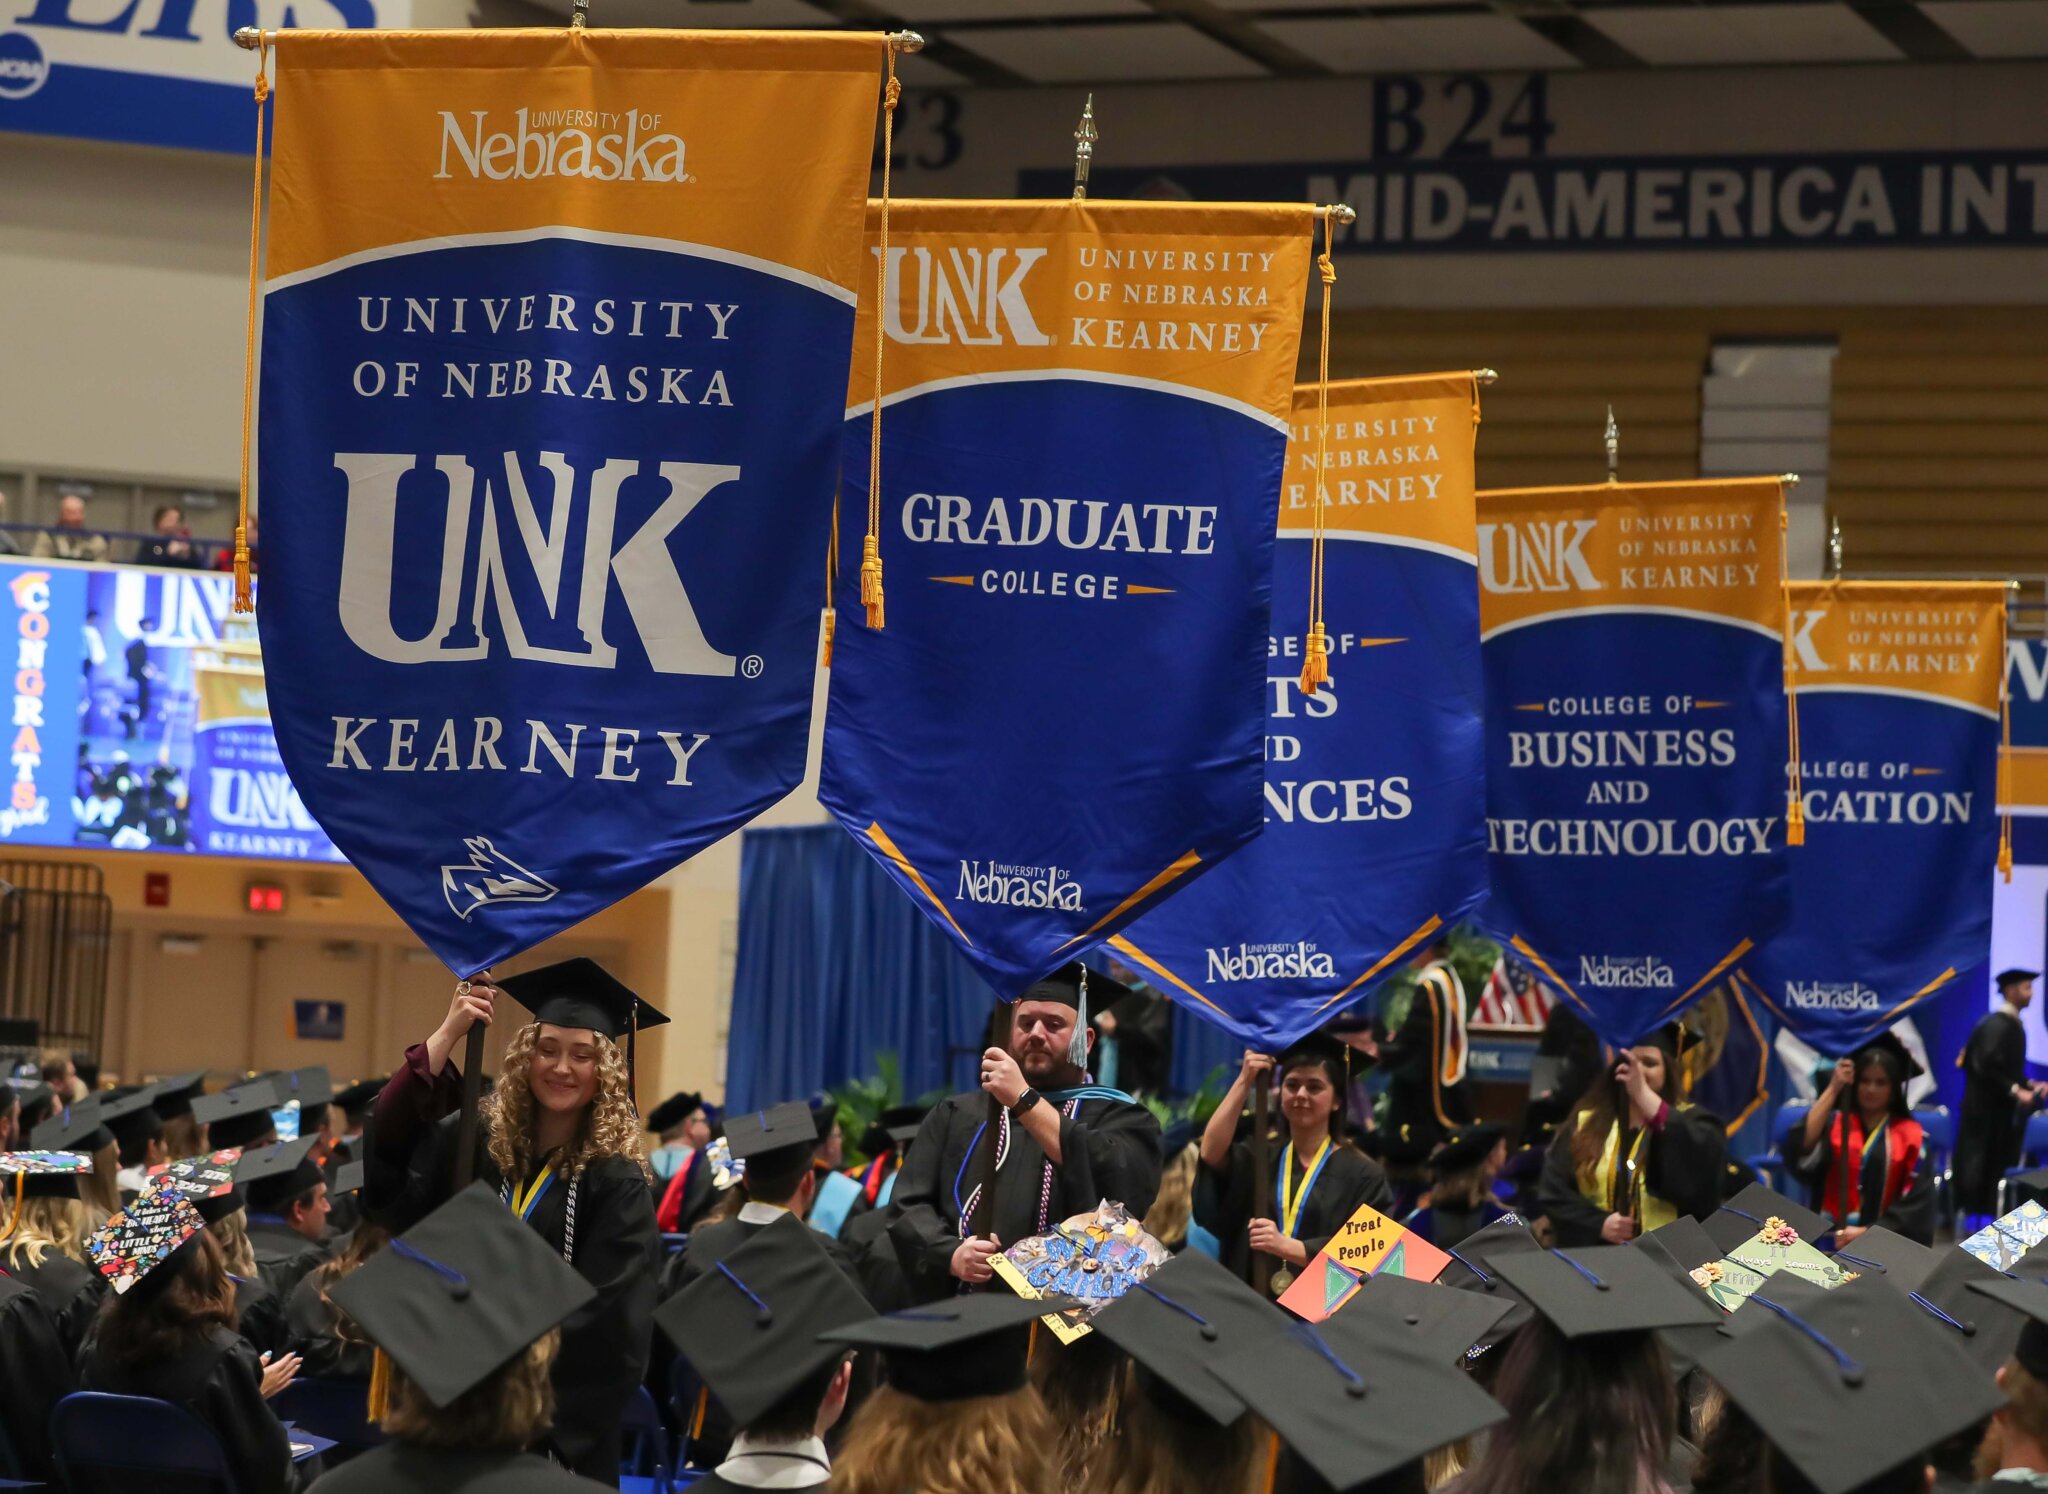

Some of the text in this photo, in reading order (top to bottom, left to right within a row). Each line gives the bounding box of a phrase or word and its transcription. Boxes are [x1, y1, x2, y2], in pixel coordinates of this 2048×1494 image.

[532, 109, 661, 131] UNIVERSITY OF
[1371, 72, 1555, 159] B24
[433, 107, 690, 183] Nebraska
[1305, 165, 1897, 243] MID-AMERICA
[1079, 247, 1275, 273] UNIVERSITY
[871, 247, 1050, 346] UNK
[1074, 281, 1269, 307] OF NEBRASKA
[359, 294, 738, 339] UNIVERSITY
[1071, 318, 1269, 352] KEARNEY
[354, 358, 734, 406] OF NEBRASKA
[1287, 416, 1437, 442] NIVERSITY
[1302, 444, 1440, 470] NEBRASKA
[1281, 474, 1442, 509] EARNEY
[902, 493, 1217, 555] GRADUATE
[1619, 514, 1755, 533] UNIVERSITY
[1476, 520, 1600, 593] UNK
[1619, 538, 1757, 557] OF NEBRASKA
[334, 450, 741, 677] UNK
[982, 569, 1119, 600] COLLEGE
[1620, 564, 1760, 590] KEARNEY
[1850, 611, 1978, 625] UNIVERSITY
[1848, 631, 1979, 645] OF NEBRASKA
[1848, 653, 1981, 673] KEARNEY
[11, 582, 50, 810] CONGRATS
[1548, 696, 1692, 716] COLLEGE OF
[327, 716, 710, 786] KEARNEY
[1509, 729, 1736, 767] BUSINESS
[1881, 763, 1909, 779] OF
[1264, 777, 1412, 823] NCES
[1586, 780, 1649, 804] AND
[1486, 817, 1778, 856] TECHNOLOGY
[995, 864, 1070, 880] UNIVERSITY OF
[955, 860, 1083, 912] Nebraska
[1248, 943, 1317, 954] UNIVERSITY OF
[1205, 941, 1336, 983] Nebraska
[1579, 955, 1675, 987] Nebraska
[1785, 980, 1879, 1010] Nebraska
[141, 1213, 171, 1226] HEART
[150, 1224, 172, 1235] shape
[1345, 1216, 1382, 1235] Treat
[119, 1236, 151, 1249] LITTLE
[131, 1244, 158, 1256] MINDS
[1339, 1238, 1385, 1260] People
[1785, 1260, 1822, 1271] seems
[1027, 1261, 1138, 1298] CHILD
